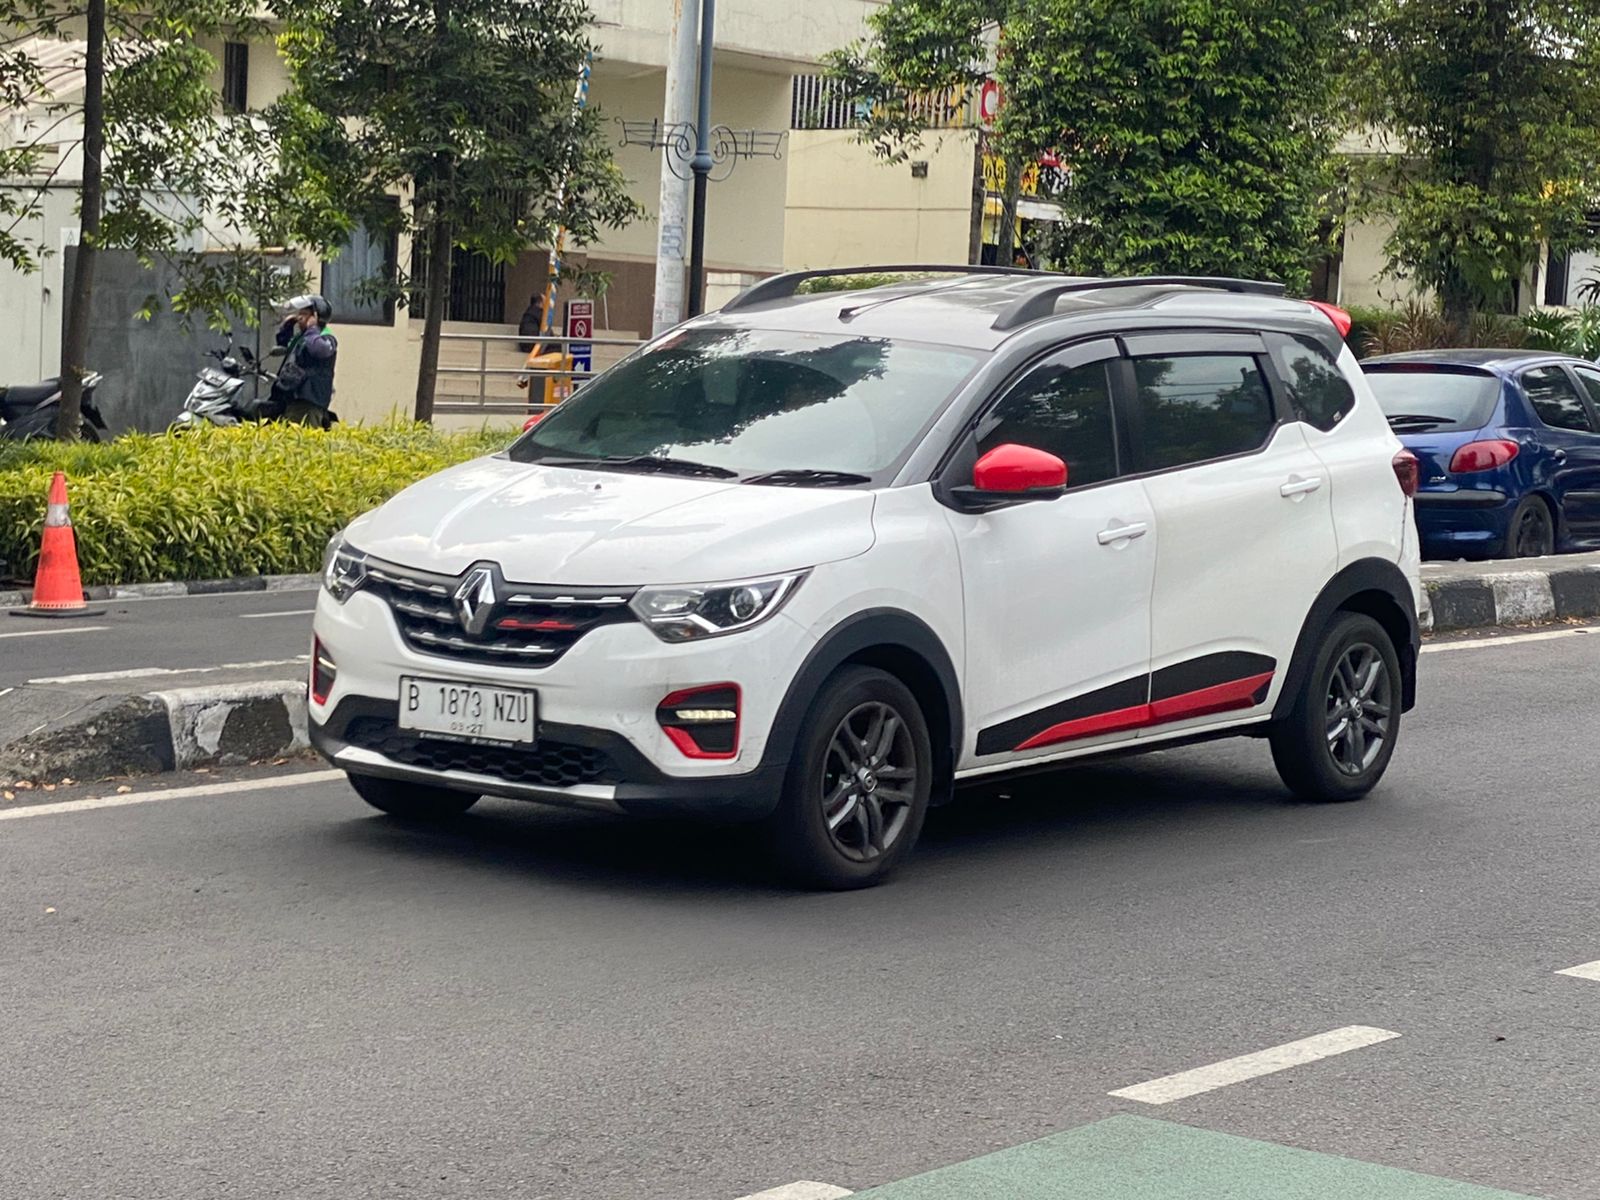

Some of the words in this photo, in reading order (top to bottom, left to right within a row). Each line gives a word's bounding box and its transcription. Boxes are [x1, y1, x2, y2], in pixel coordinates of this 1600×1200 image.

[408, 684, 420, 711] B
[439, 687, 482, 717] 1873
[493, 692, 528, 723] NZU
